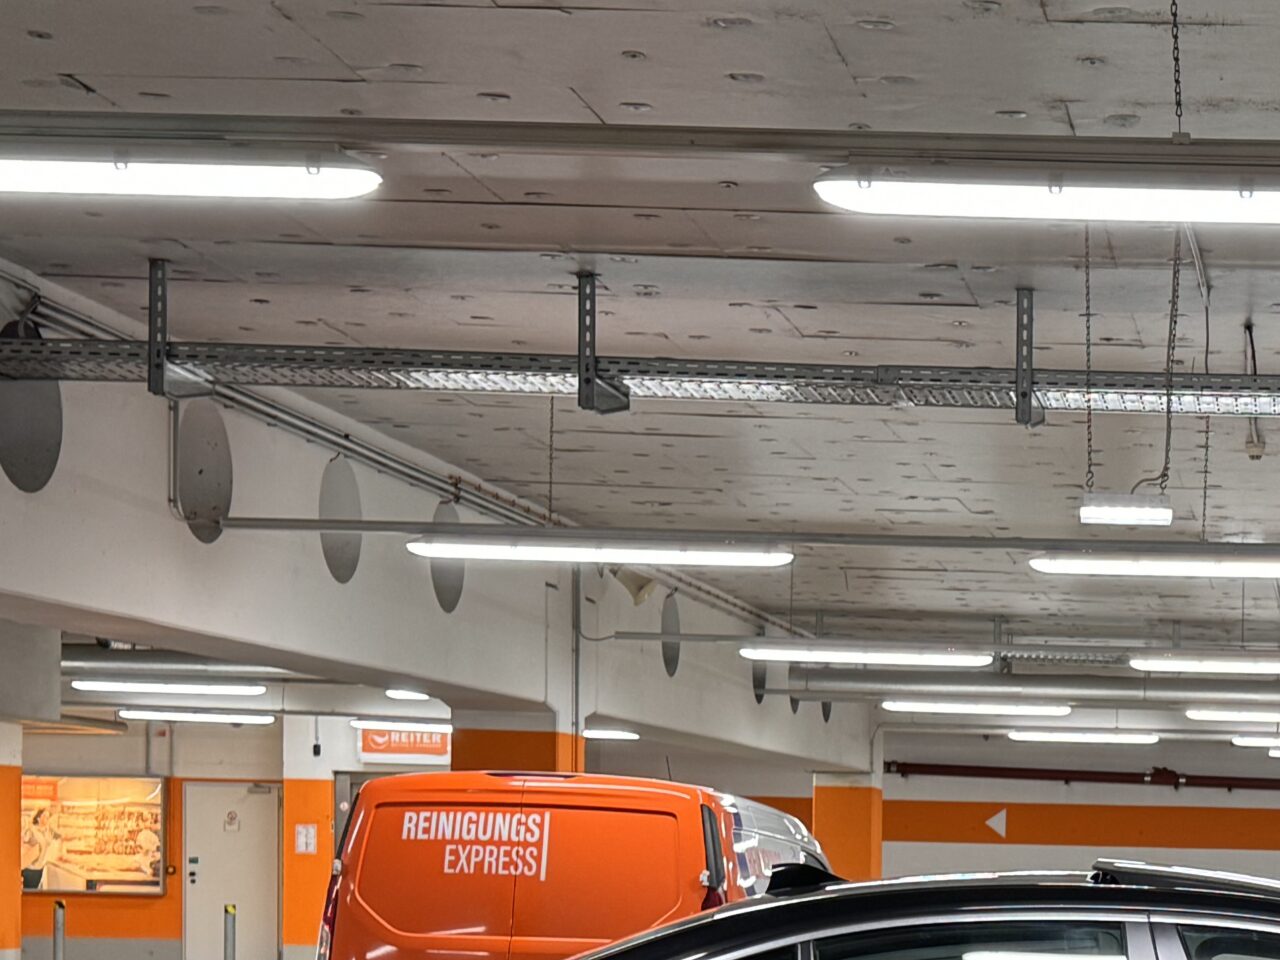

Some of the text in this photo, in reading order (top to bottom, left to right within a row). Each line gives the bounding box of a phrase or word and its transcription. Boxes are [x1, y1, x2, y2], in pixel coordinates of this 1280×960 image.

[390, 731, 442, 744] REITER
[401, 811, 542, 843] REINIGUNGS
[443, 844, 539, 877] EXPRESS
